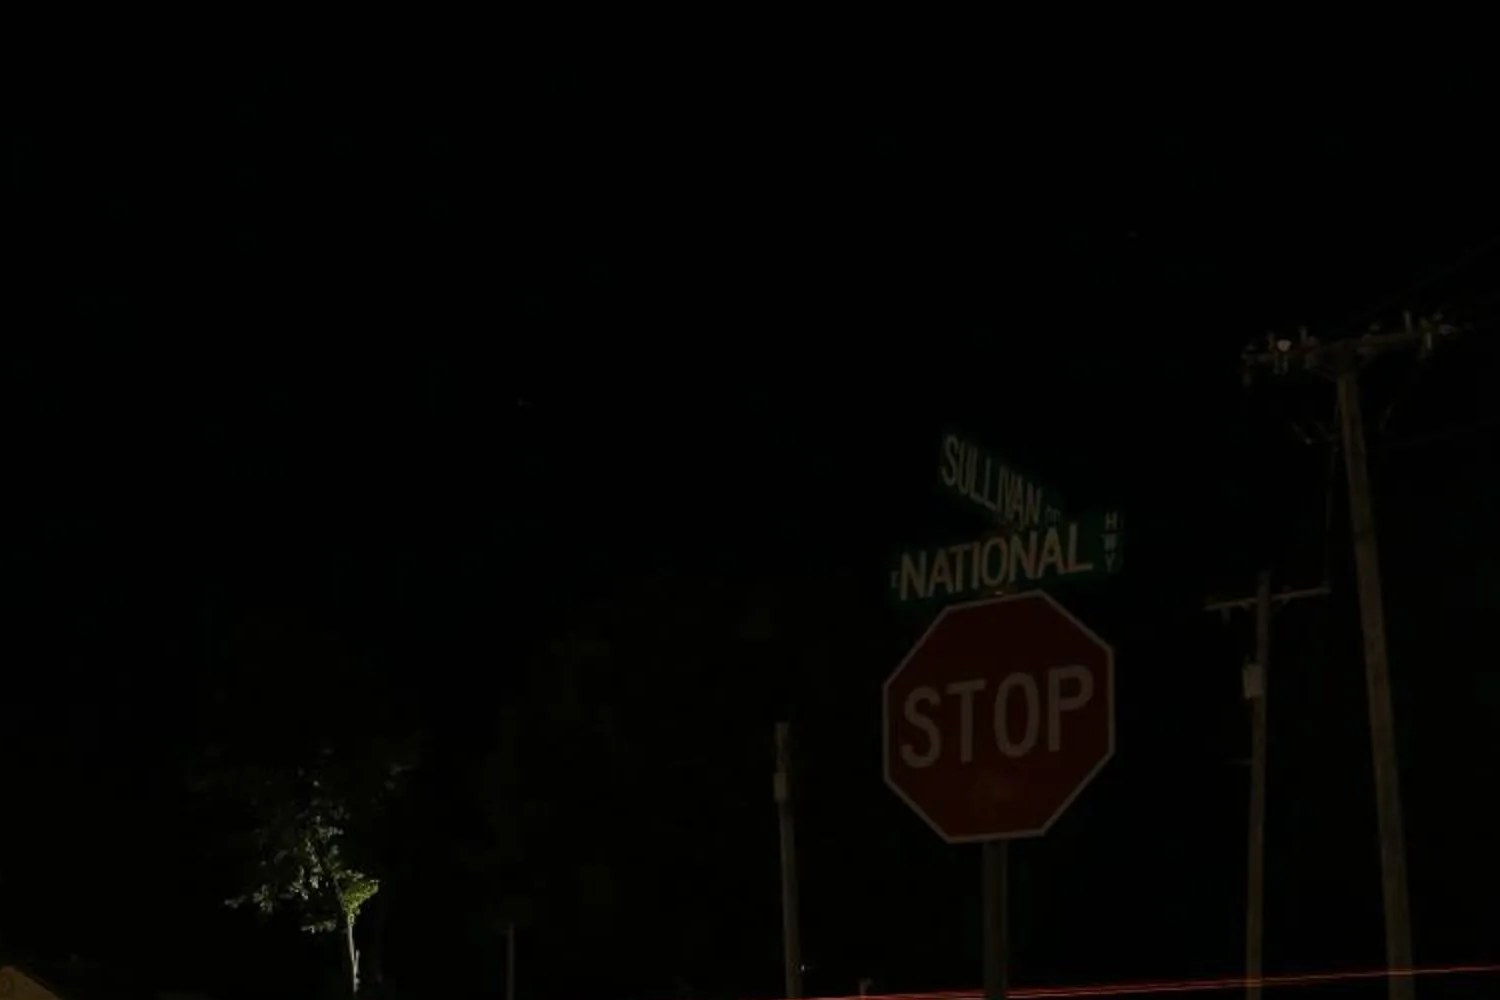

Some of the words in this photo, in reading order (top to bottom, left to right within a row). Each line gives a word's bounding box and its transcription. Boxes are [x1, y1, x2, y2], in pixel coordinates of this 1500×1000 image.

[940, 434, 1042, 531] SULLIVAN
[900, 523, 1094, 601] NATIONAL
[900, 664, 1094, 770] STOP
